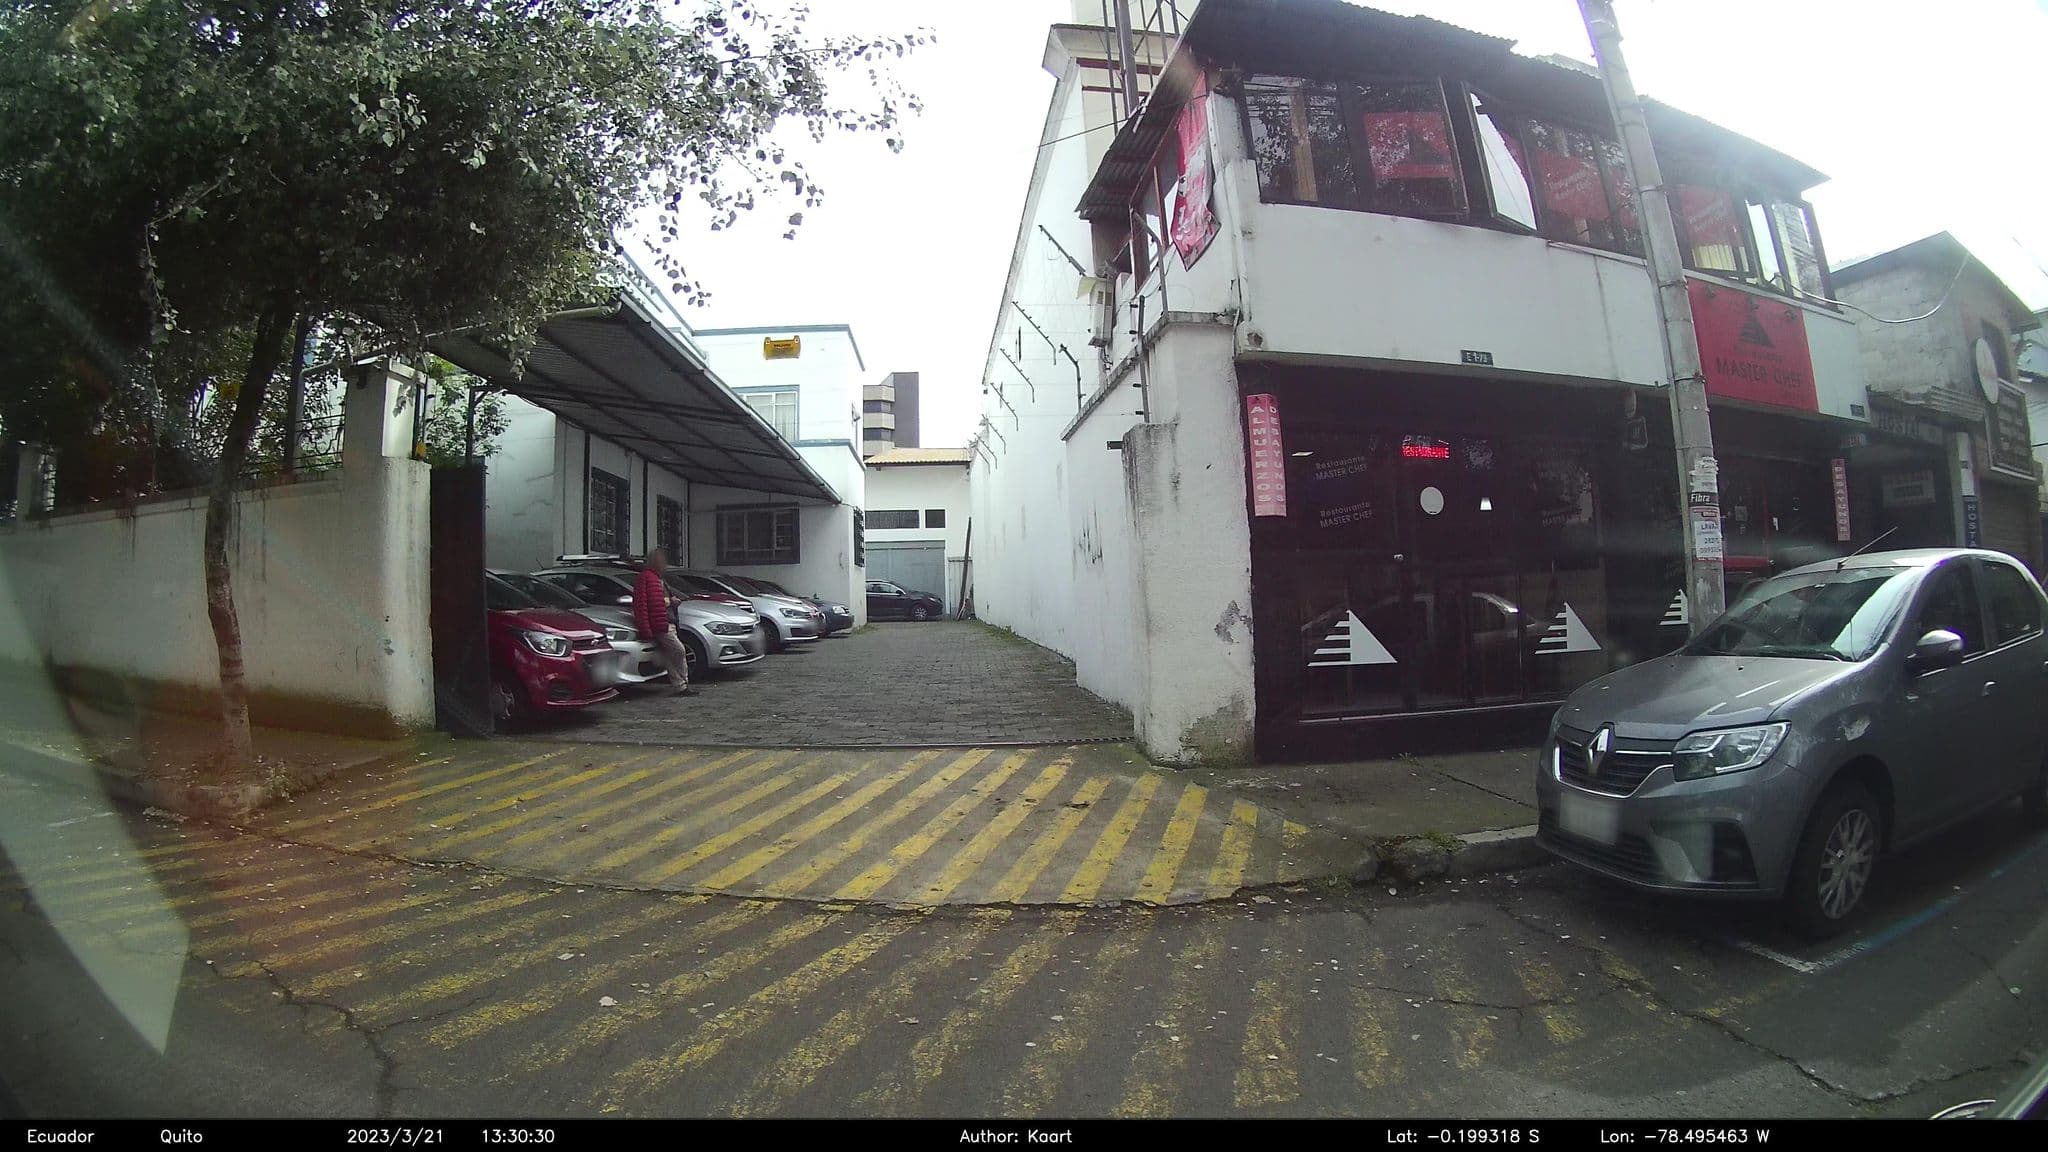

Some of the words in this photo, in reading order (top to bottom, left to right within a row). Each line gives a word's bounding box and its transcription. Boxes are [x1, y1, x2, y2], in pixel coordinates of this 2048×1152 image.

[1716, 357, 1768, 384] MASTER
[1251, 405, 1271, 502] ALMUERZOS
[1270, 405, 1284, 502] DESAYUNOS
[1315, 467, 1347, 480] MASTER
[1320, 513, 1352, 528] MASTER
